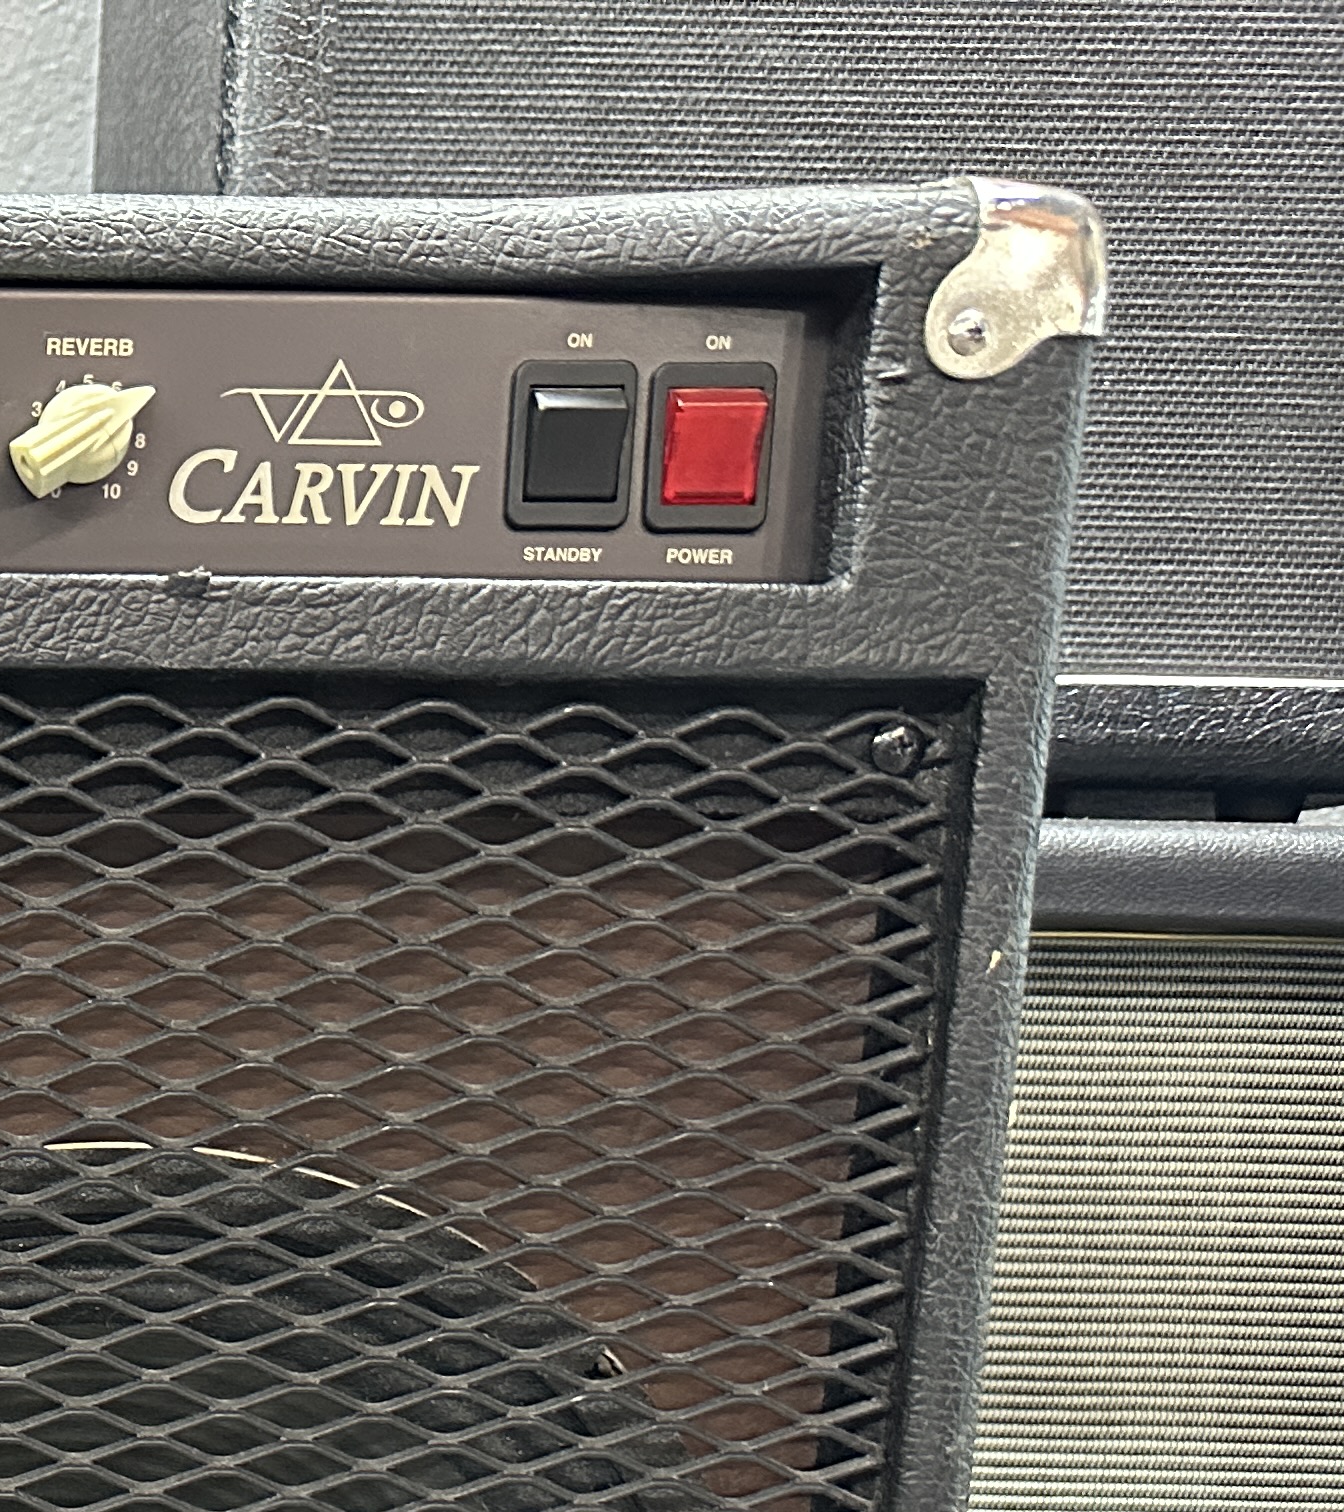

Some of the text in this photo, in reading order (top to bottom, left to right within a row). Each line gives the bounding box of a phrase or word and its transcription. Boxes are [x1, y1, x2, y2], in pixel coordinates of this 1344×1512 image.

[46, 337, 134, 357] REVERB
[567, 332, 593, 348] ON
[705, 335, 731, 351] ON
[55, 379, 66, 392] 4
[31, 401, 42, 417] 3
[134, 433, 146, 449] 8
[127, 461, 139, 477] 9
[102, 483, 121, 499] 10
[168, 448, 481, 527] CARVIN
[523, 547, 602, 563] STANDBY
[666, 548, 733, 565] POWER
